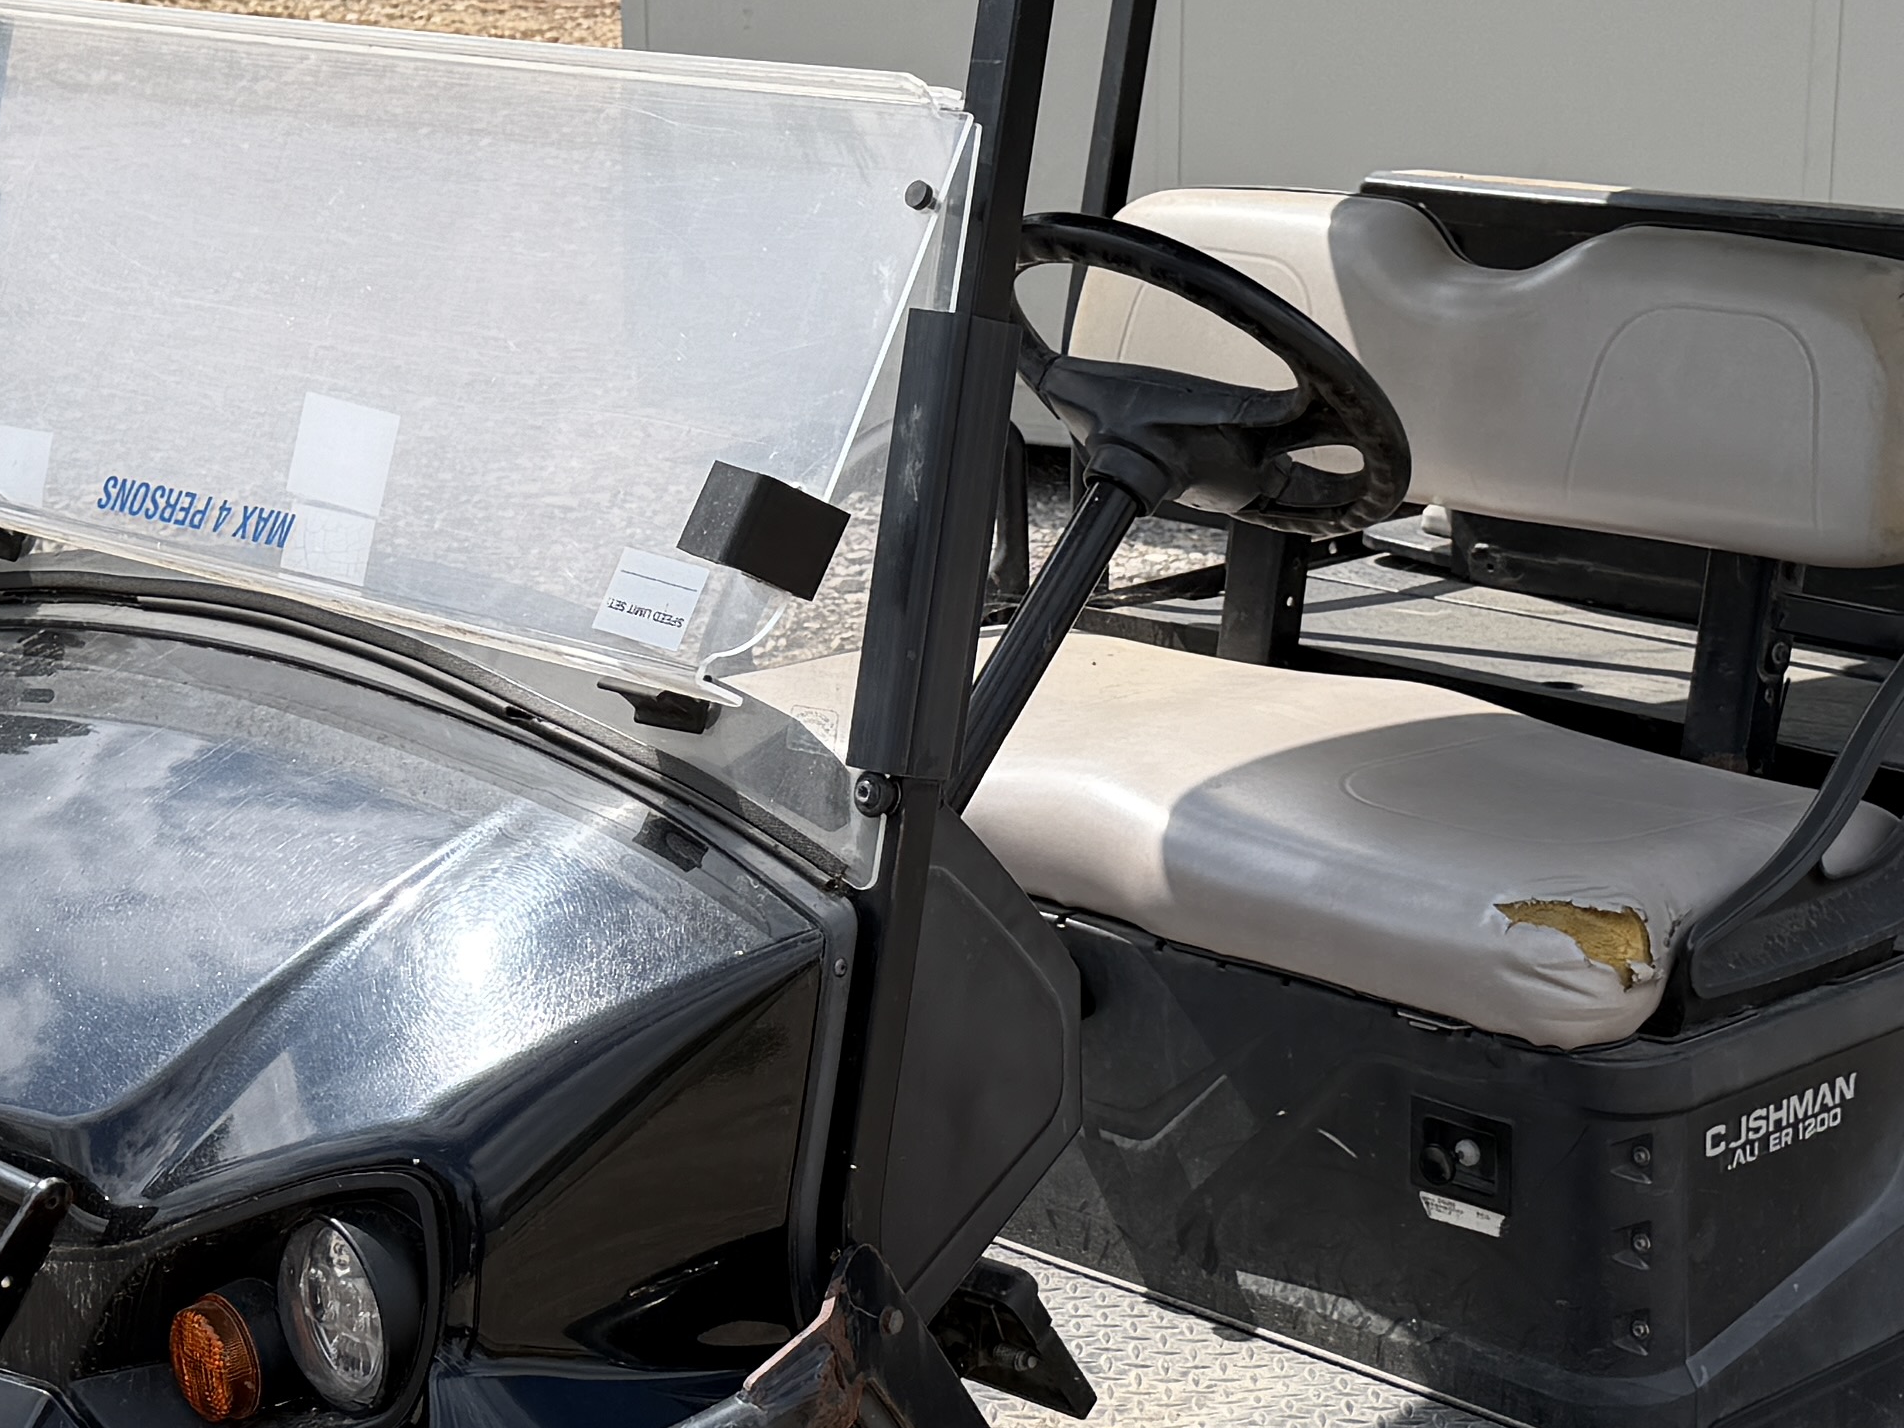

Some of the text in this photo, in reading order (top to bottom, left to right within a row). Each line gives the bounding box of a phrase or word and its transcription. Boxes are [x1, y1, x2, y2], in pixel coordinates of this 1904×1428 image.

[97, 475, 296, 548] MAX 4 PERSONS
[626, 604, 653, 620] LIMIT
[652, 611, 685, 628] SPEED
[1799, 1107, 1842, 1141] 1200
